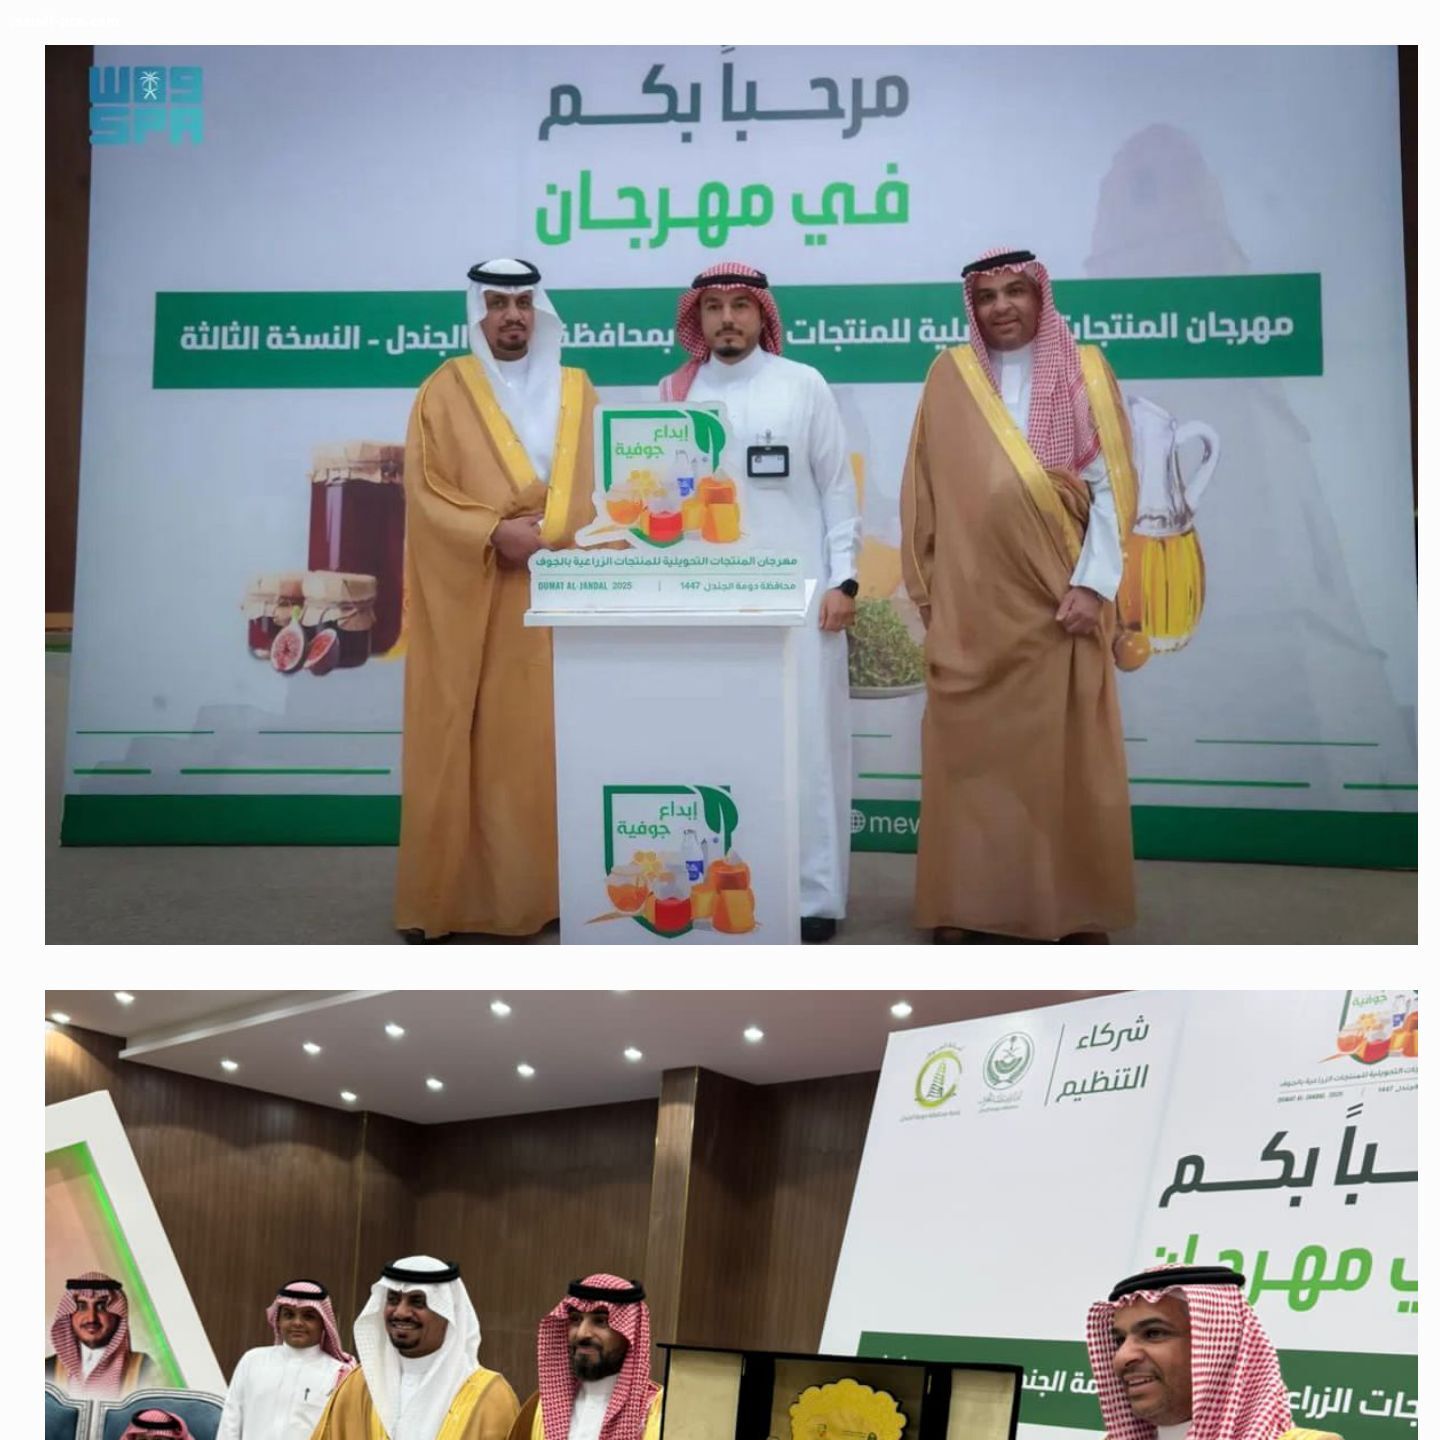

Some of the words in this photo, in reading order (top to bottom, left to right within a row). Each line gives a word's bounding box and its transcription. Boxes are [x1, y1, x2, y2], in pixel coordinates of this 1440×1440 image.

[538, 63, 702, 143] بكم
[535, 169, 774, 249] مهرجان
[793, 163, 910, 246] في
[180, 320, 260, 350] الثالثة
[266, 323, 361, 350] النسخة
[786, 318, 911, 353] للمنتجات
[1185, 311, 1294, 345] مهرجان
[386, 323, 467, 357] الجندل
[653, 424, 689, 442] إبداع
[614, 442, 664, 457] جوفية
[535, 556, 572, 568] بالجوف
[573, 556, 613, 568] الزراعية
[614, 556, 662, 568] للمنتجات
[663, 557, 709, 569] التحويلية
[710, 557, 755, 569] المنتجات
[757, 557, 798, 569] مهرجان
[537, 581, 565, 592] DUMAT
[703, 581, 735, 594] الجندل
[736, 582, 758, 593] دومة
[758, 582, 797, 592] محافظة
[658, 800, 699, 821] إبداع
[616, 820, 671, 839] جوفية
[1075, 1016, 1150, 1053] شركاء
[1055, 1063, 1150, 1103] التنظيم
[1158, 1130, 1320, 1208] بكم
